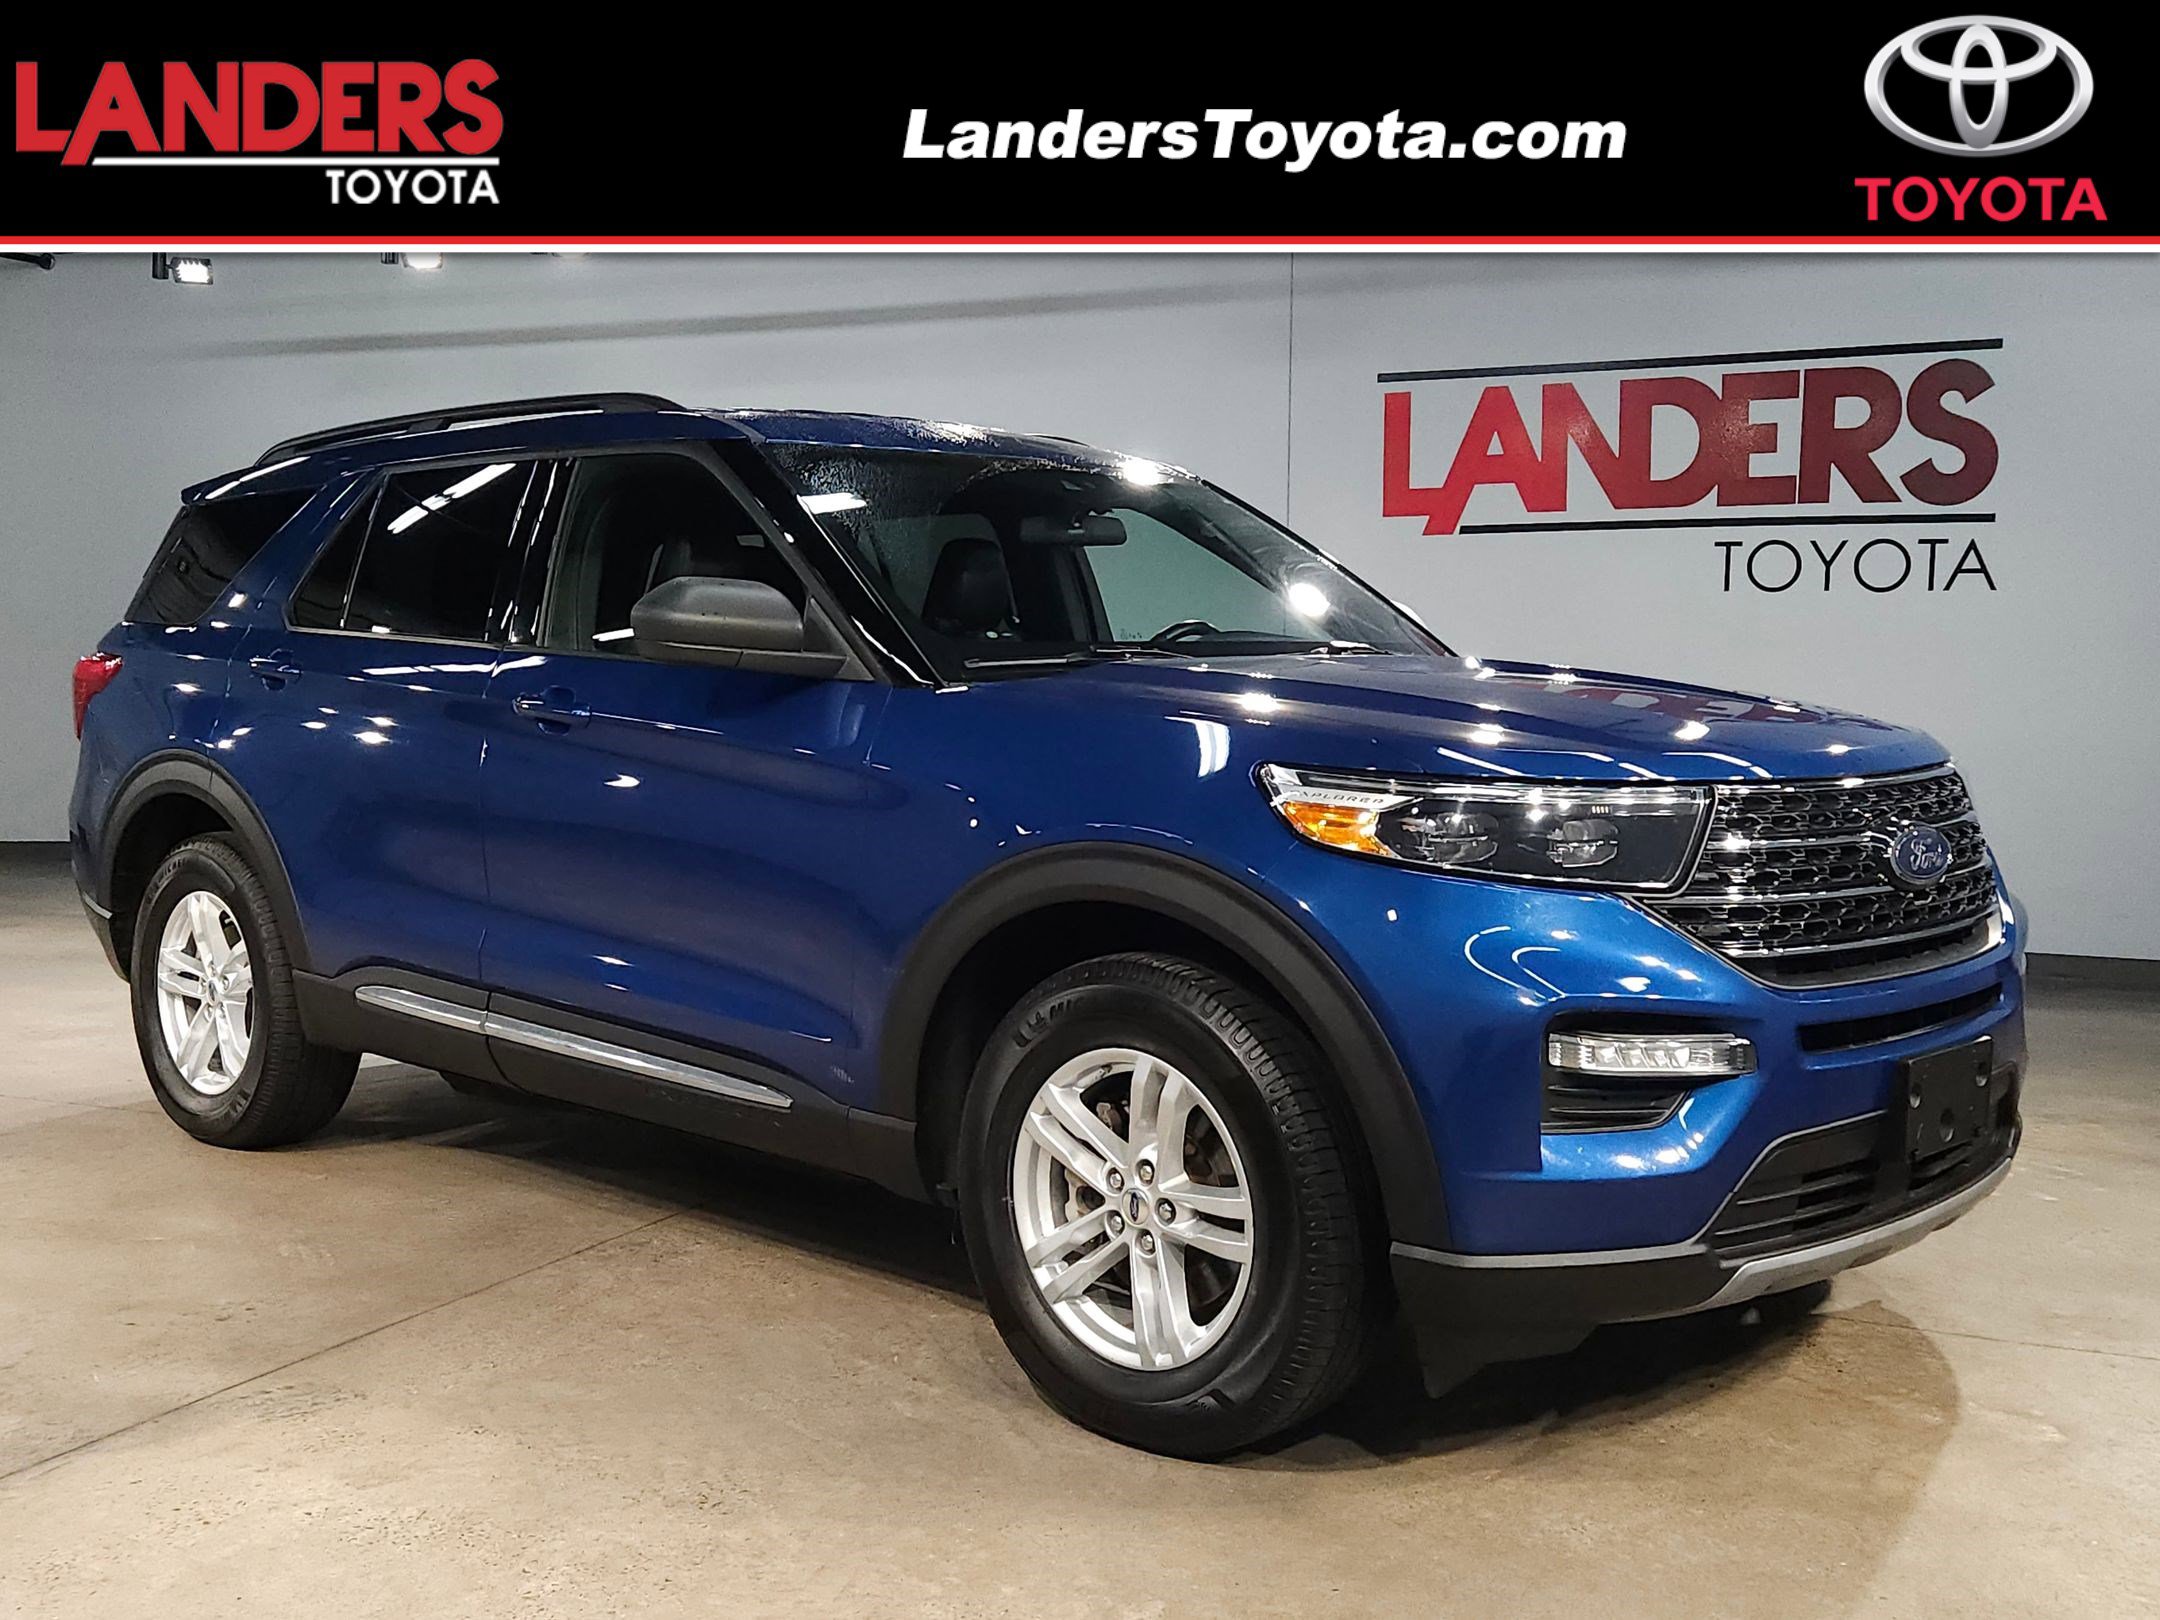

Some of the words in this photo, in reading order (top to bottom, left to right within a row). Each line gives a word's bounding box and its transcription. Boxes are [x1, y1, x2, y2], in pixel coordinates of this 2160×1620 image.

[1382, 359, 1999, 536] LANDERS
[1714, 538, 1998, 592] TOYOTA
[1289, 789, 1385, 804] XPLORER
